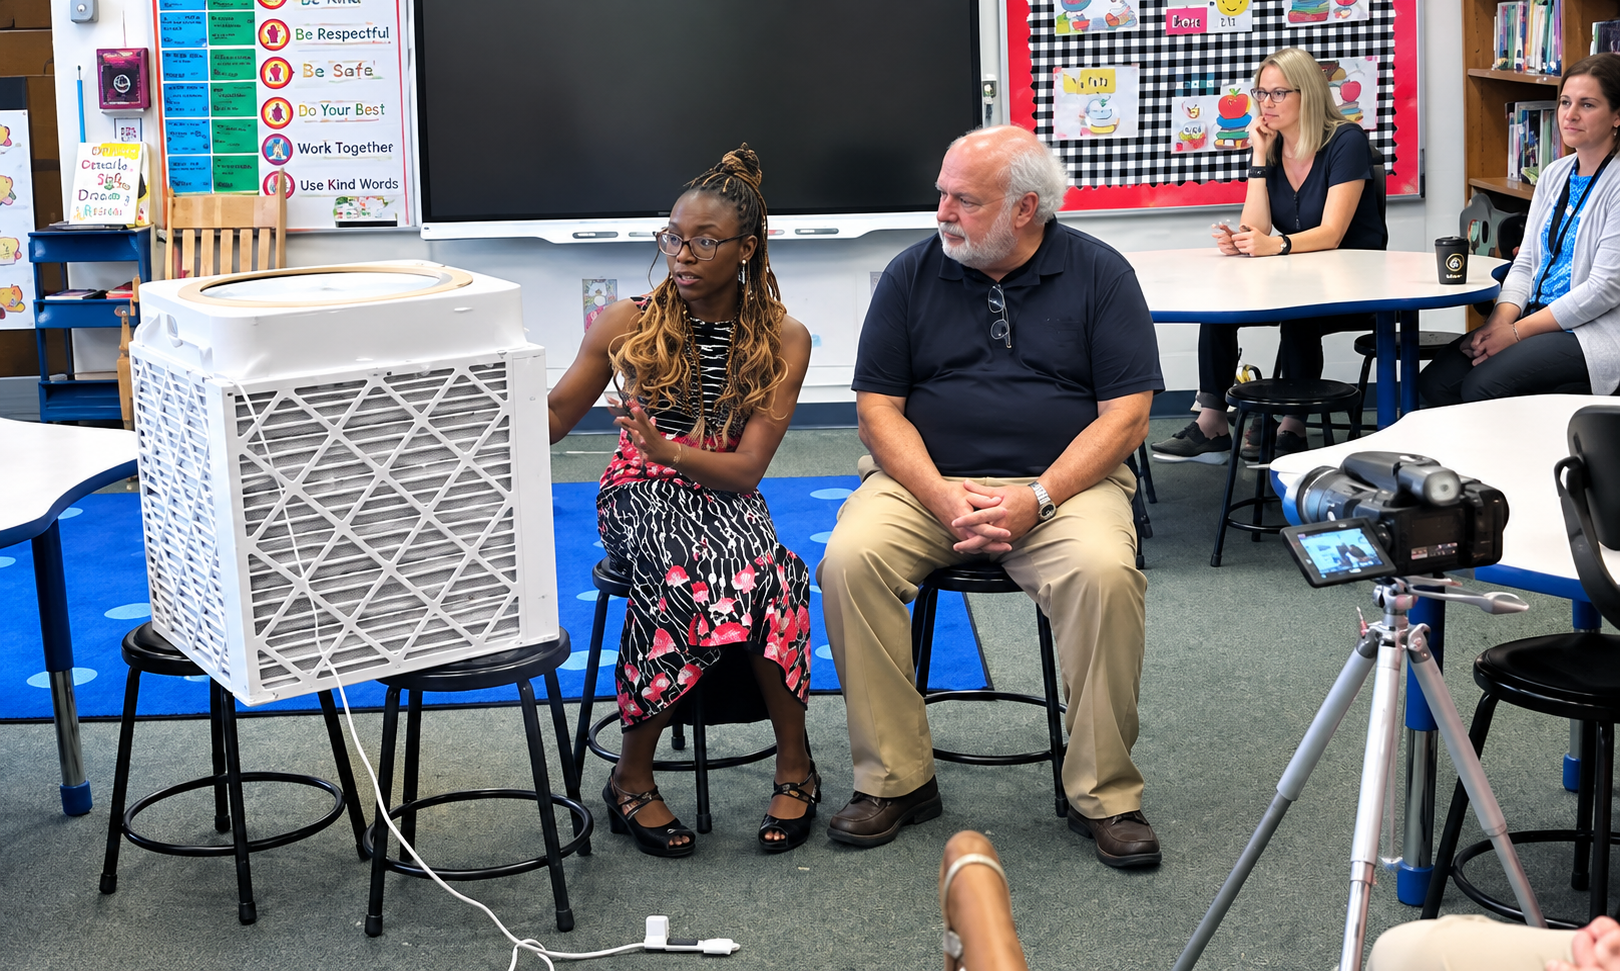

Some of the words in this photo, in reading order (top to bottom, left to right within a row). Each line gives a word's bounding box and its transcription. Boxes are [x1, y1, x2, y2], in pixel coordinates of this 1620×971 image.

[295, 28, 313, 40] Be
[318, 26, 390, 42] Respectful
[303, 63, 325, 78] Be
[333, 62, 374, 77] Safe
[298, 104, 317, 117] Do
[320, 103, 351, 116] Your
[355, 103, 385, 116] Best
[297, 141, 332, 154] Work
[335, 141, 394, 156] Together
[300, 180, 324, 191] Use
[328, 178, 356, 190] Kind
[360, 178, 399, 190] Words
